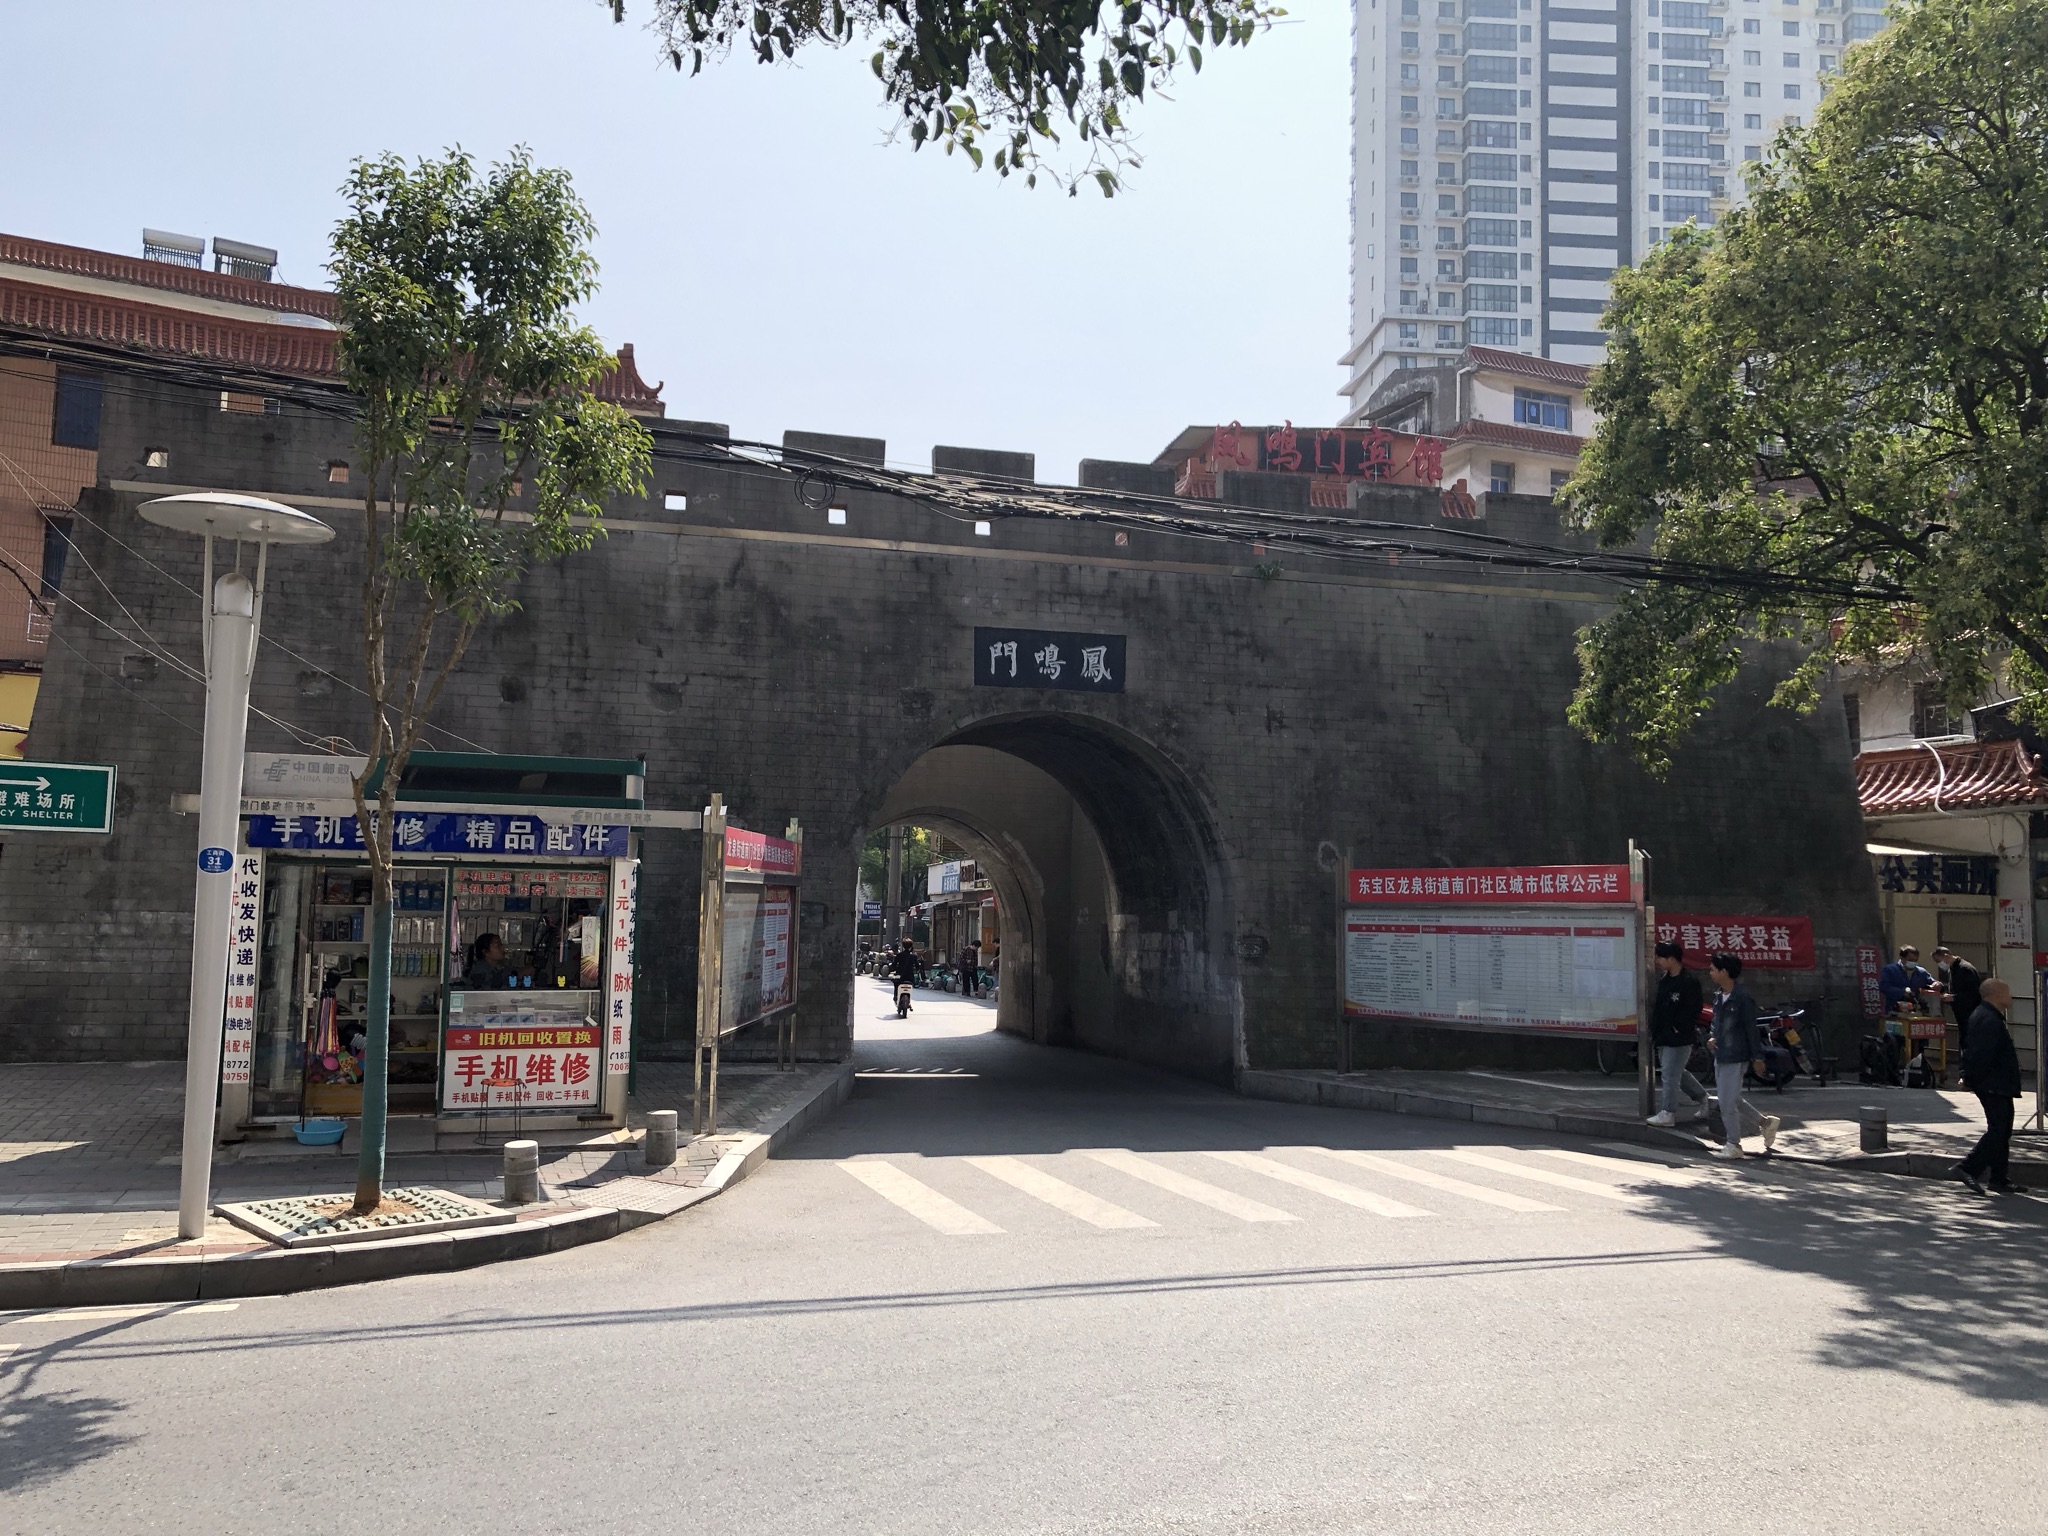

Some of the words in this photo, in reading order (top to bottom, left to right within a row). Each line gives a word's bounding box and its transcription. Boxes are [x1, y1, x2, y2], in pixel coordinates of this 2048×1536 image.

[293, 761, 350, 775] 中国邮政
[292, 774, 321, 783] CHINA
[22, 810, 74, 820] SHELTER
[466, 820, 610, 851] 精品配件
[207, 856, 222, 866] 31
[457, 870, 512, 882] 手机电池
[522, 871, 560, 882] 充电器
[1358, 873, 1619, 895] 东宝区龙泉街道南门社区城市低保公示栏
[457, 883, 511, 895] 手机贴膜
[519, 884, 558, 896] 内存卡
[567, 886, 606, 897] 读卡器
[236, 858, 259, 966] 代收发快递
[613, 878, 629, 952] 1元1件
[1658, 922, 1792, 951] 灾害家家受益
[1859, 949, 1878, 974] 开锁
[614, 972, 633, 992] 防水
[1863, 977, 1882, 1015] 换锁芯
[479, 1031, 592, 1046] 旧机回收置换
[454, 1052, 591, 1088] 手机维修
[452, 1092, 489, 1104] 手机贴膜
[495, 1091, 532, 1103] 手机配件
[536, 1089, 590, 1101] 回收二手手机
